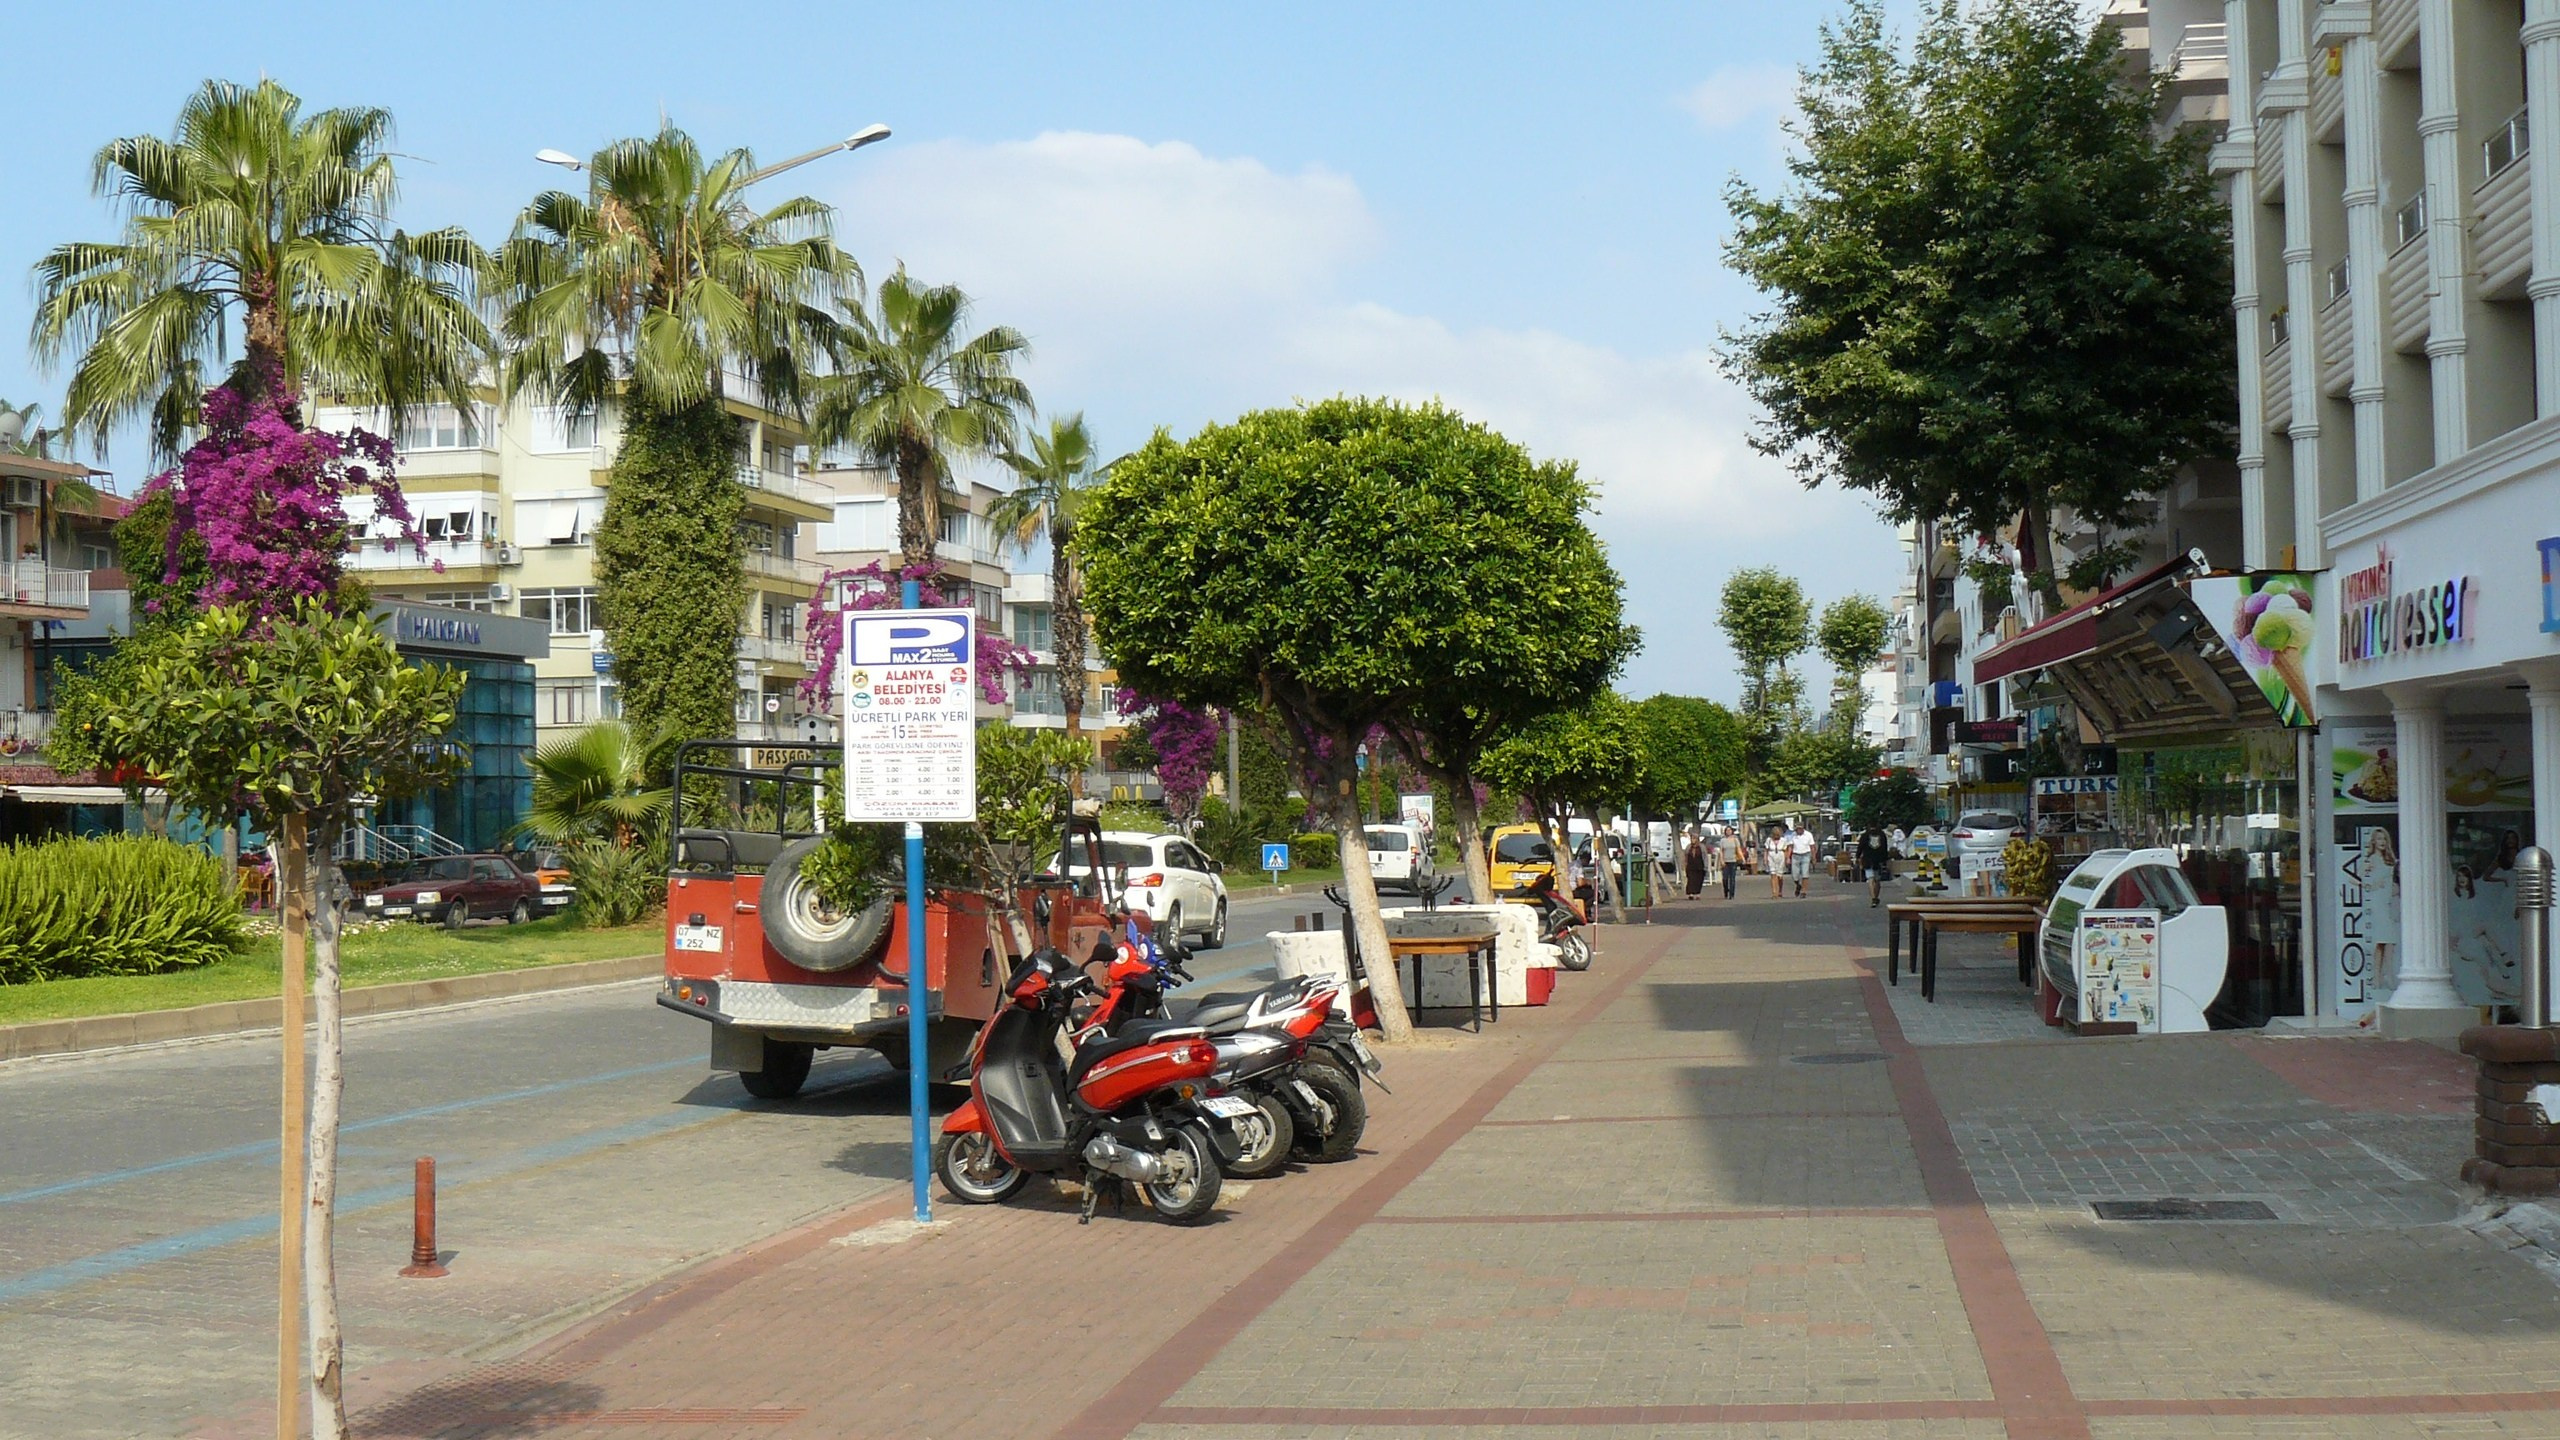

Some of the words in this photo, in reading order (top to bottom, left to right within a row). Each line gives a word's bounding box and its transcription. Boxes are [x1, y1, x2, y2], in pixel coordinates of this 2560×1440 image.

[2347, 564, 2386, 606] VIKING
[2340, 561, 2468, 664] hairdresser
[412, 616, 481, 644] HALKBANK
[856, 618, 965, 664] P
[893, 653, 920, 663] MAX
[920, 648, 932, 663] 2
[886, 670, 934, 680] ALANYA
[874, 681, 946, 695] BELEDİYESİ
[879, 697, 906, 705] 08.00
[915, 697, 941, 705] 22.00
[905, 711, 937, 722] PARK
[942, 708, 968, 722] YERİ
[891, 724, 906, 739] 15
[2040, 777, 2118, 793] TURK
[678, 926, 689, 936] 07
[706, 929, 720, 939] NZ
[686, 938, 704, 949] 252
[1269, 993, 1295, 1008] YAMAHA
